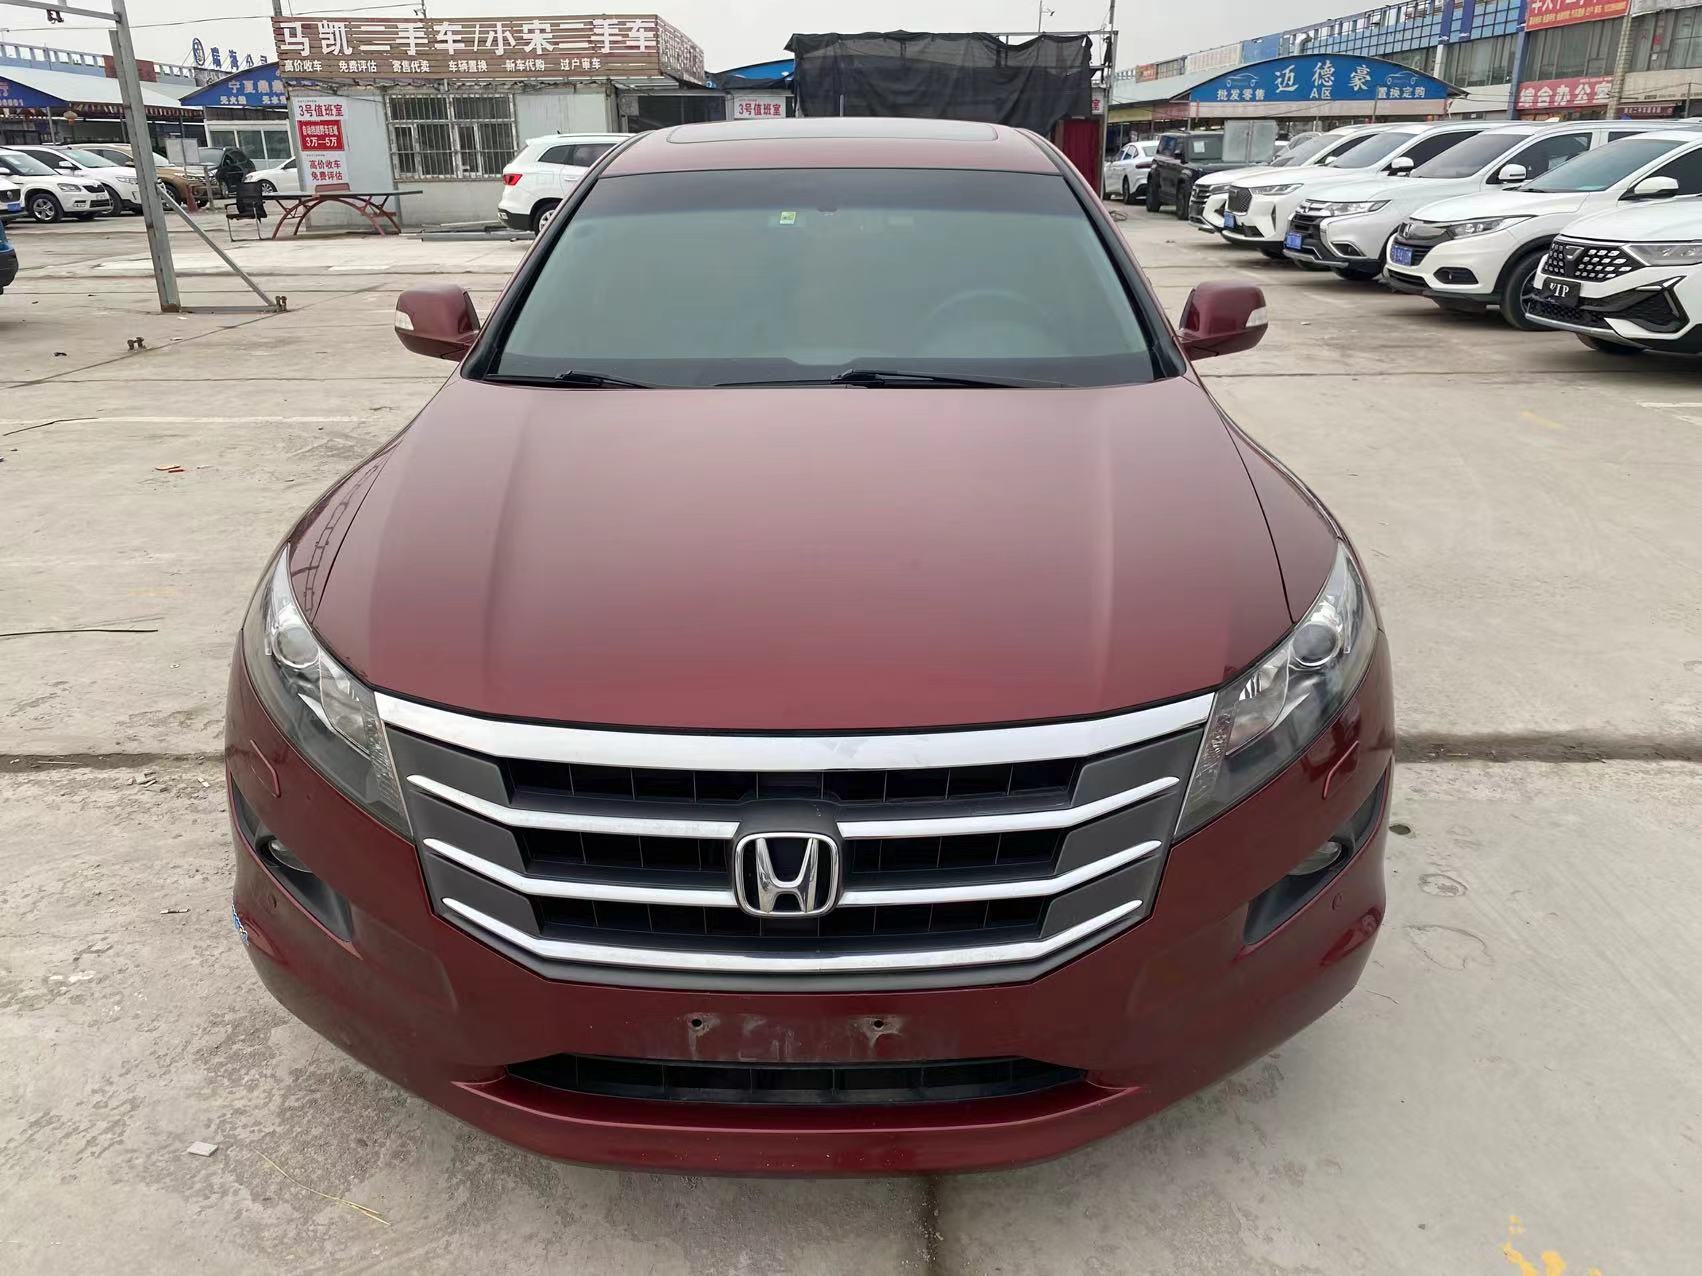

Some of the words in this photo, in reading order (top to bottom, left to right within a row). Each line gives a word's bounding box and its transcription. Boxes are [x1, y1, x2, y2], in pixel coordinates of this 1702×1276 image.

[280, 18, 657, 57] 马凯二手车/小宋二手车
[284, 60, 323, 73] 高价收车
[339, 60, 377, 73] 免费评估
[448, 59, 488, 72] 车辆置换
[505, 59, 545, 72] 新车代购
[560, 58, 601, 71] 过户审车
[1275, 60, 1371, 94] 迈德豪
[1217, 89, 1266, 101] 批发零售
[1310, 87, 1331, 99] A区
[1378, 87, 1425, 98] 置换定购
[1518, 82, 1614, 107] 综合办公室
[298, 104, 344, 117] 3号值班室
[739, 103, 782, 116] 3号值班室
[309, 160, 342, 170] 高价收车
[312, 171, 343, 181] 免费评估
[1549, 282, 1571, 298] VIP
